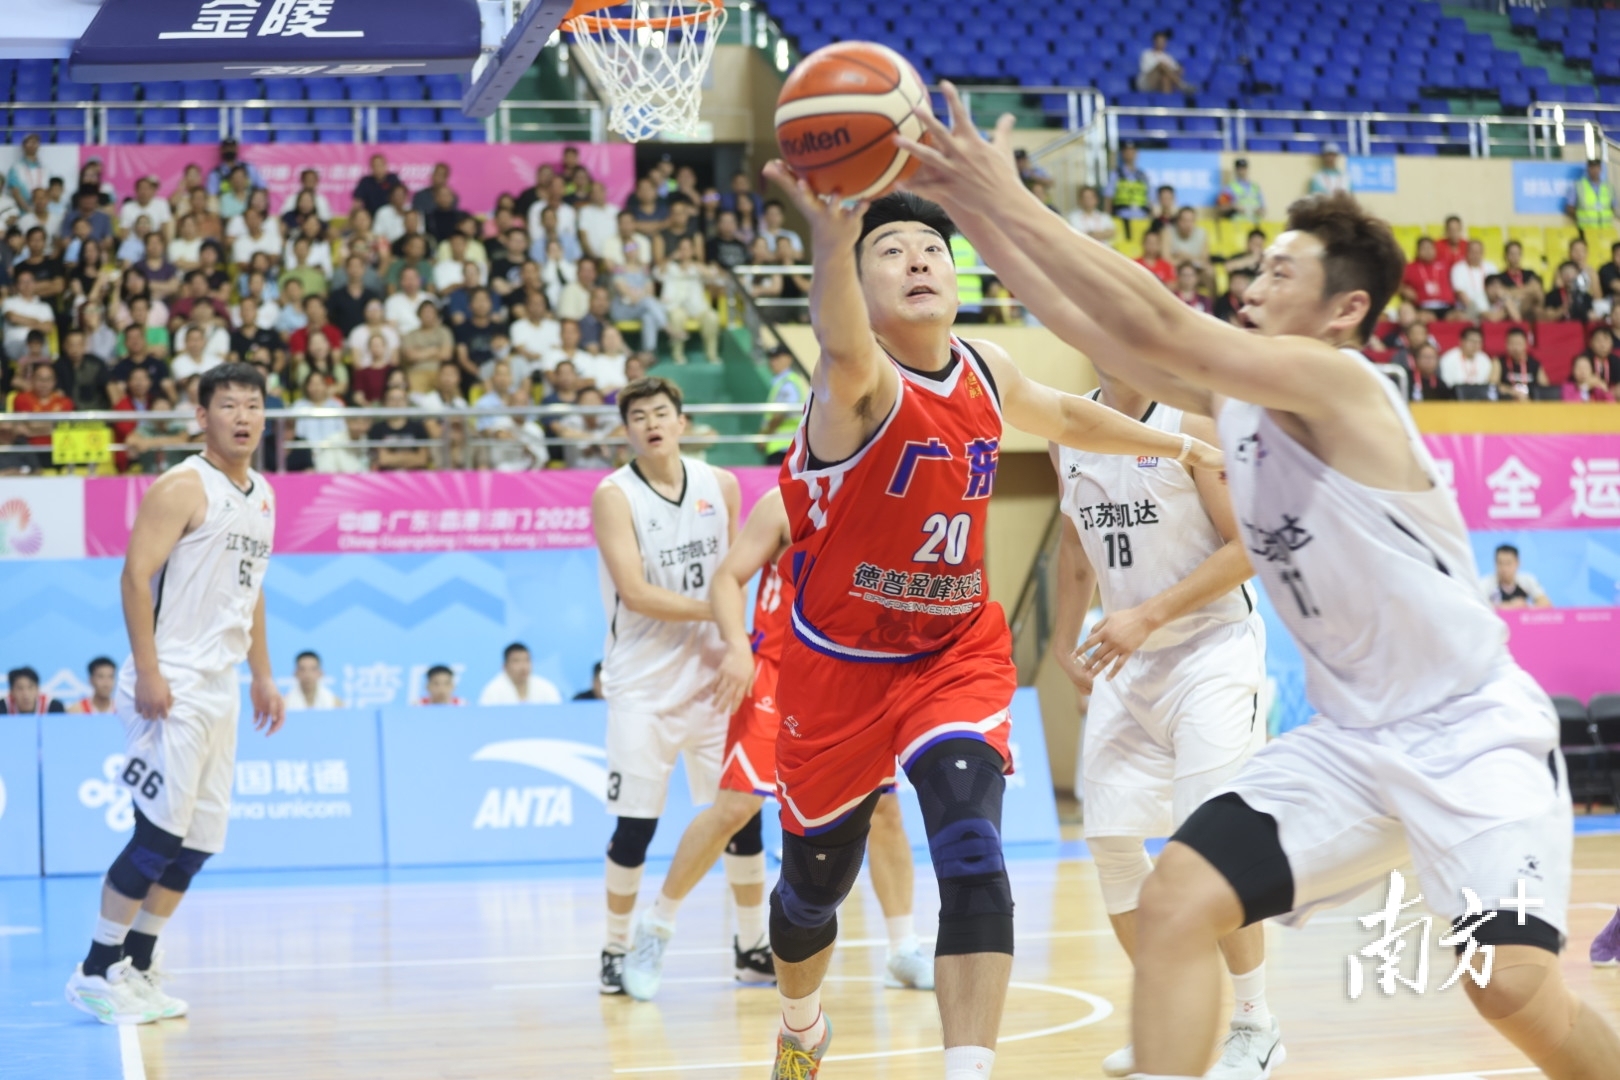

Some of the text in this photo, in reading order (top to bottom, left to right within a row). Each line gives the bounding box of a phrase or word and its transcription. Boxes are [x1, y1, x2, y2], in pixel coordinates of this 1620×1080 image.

[158, 0, 365, 39] 金陵
[885, 437, 999, 500] 广东
[1434, 454, 1620, 519] 全运
[1080, 499, 1159, 531] 江苏凯达
[911, 512, 972, 566] 20
[1103, 532, 1134, 569] 18
[122, 757, 164, 800] 66
[472, 786, 573, 830] ANTA
